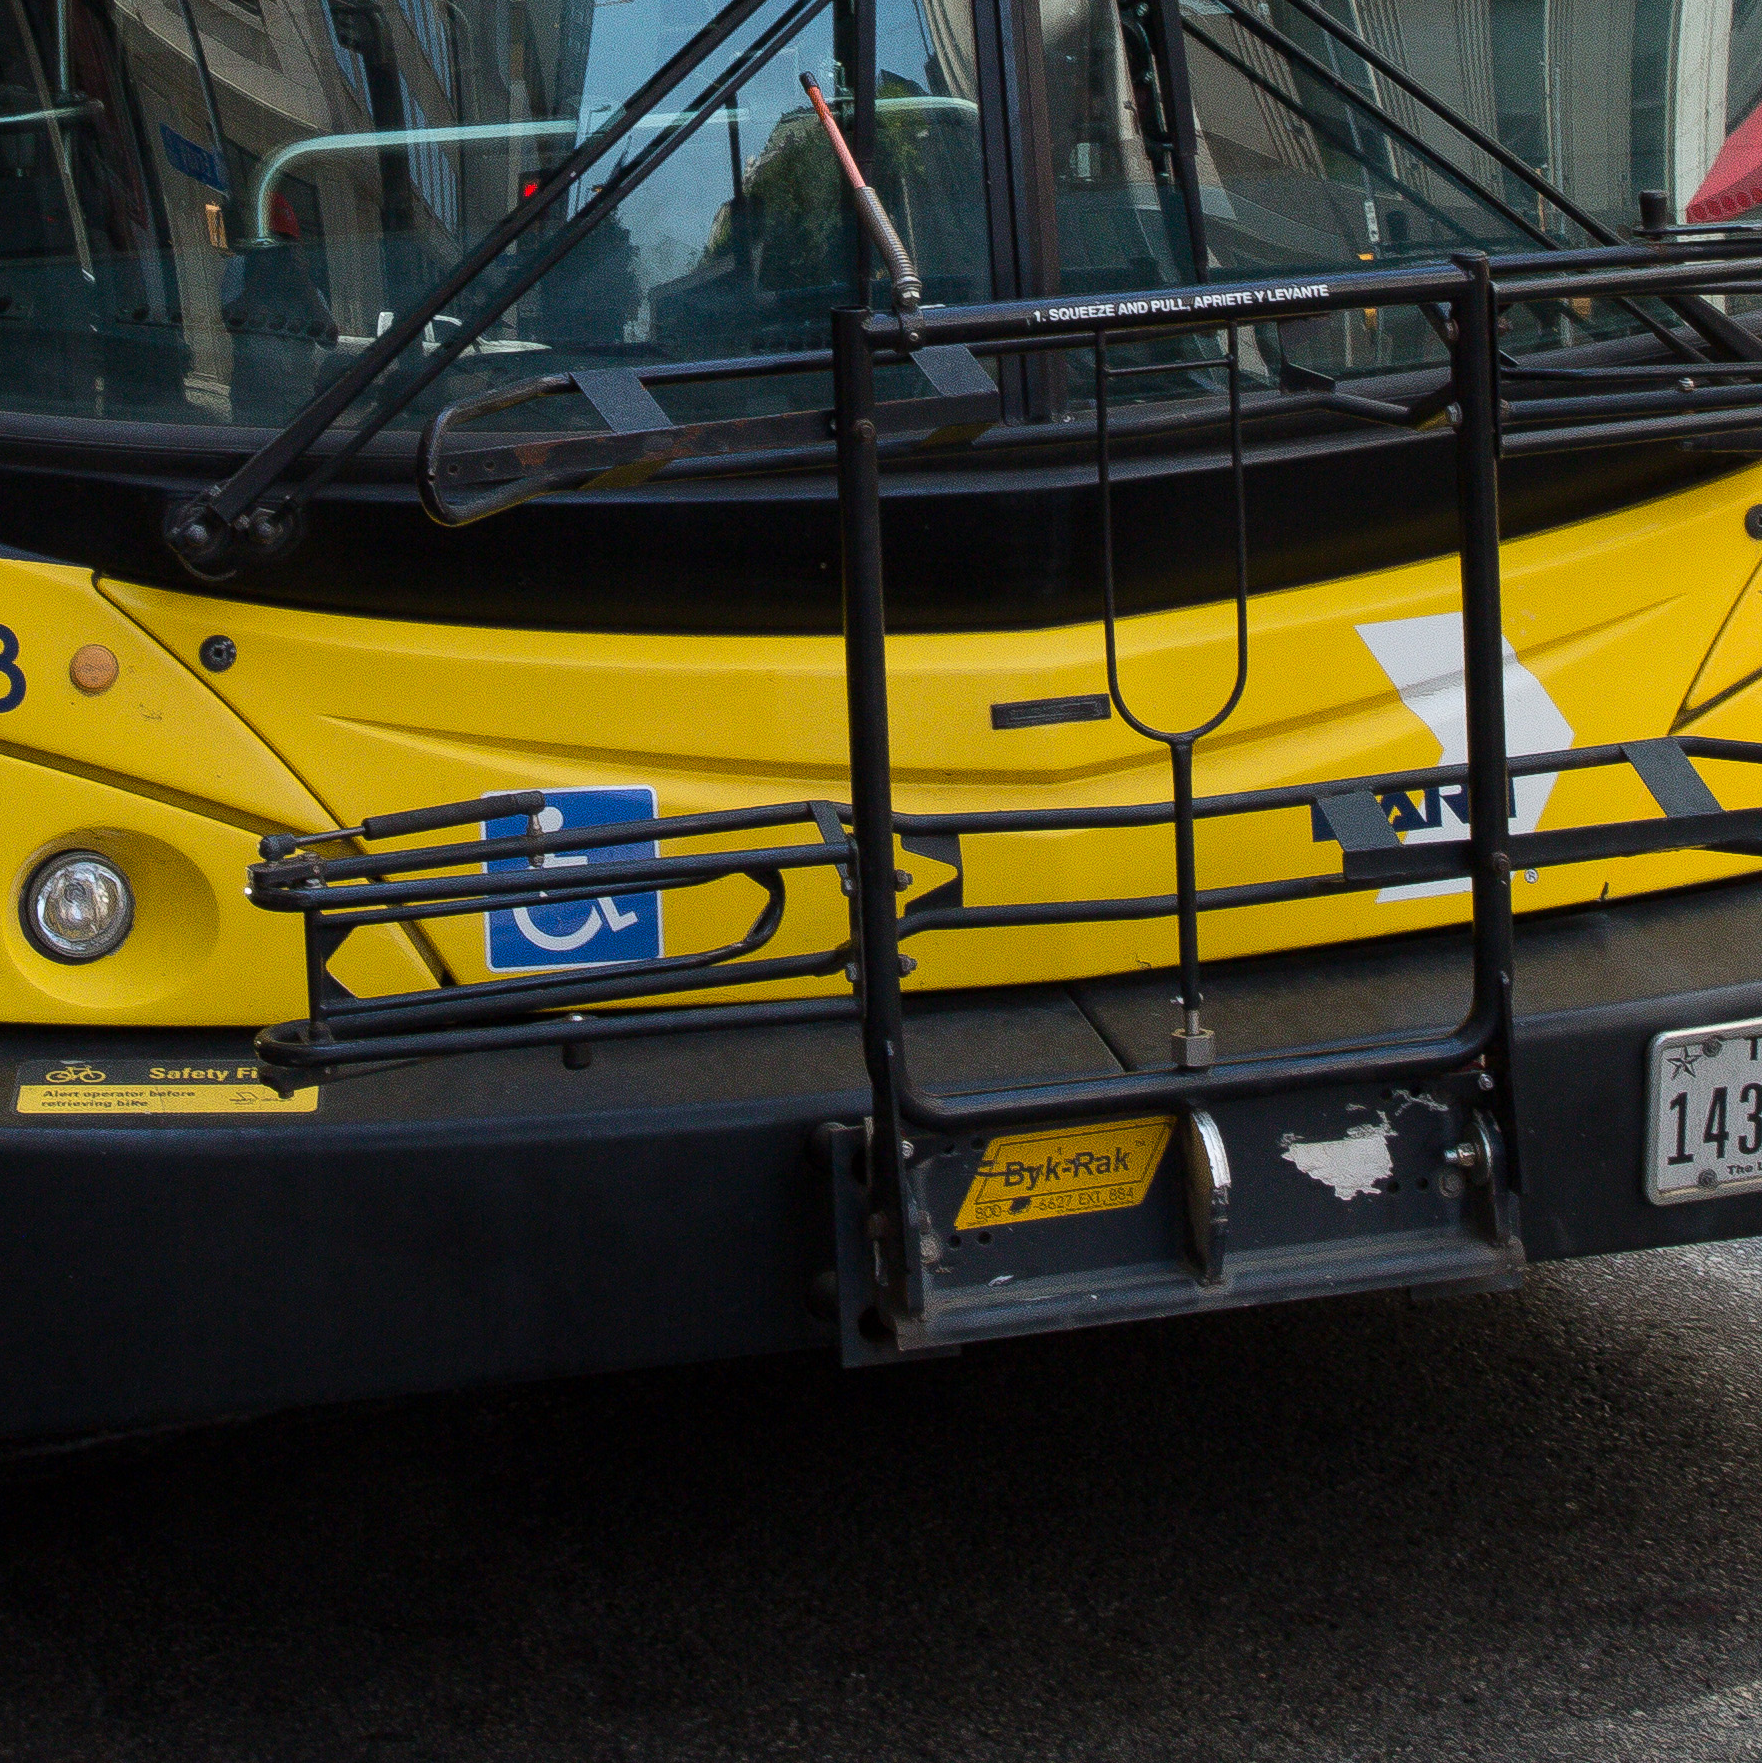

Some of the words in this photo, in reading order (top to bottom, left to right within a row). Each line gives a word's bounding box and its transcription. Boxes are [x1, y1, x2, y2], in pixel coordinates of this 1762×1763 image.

[1033, 310, 1046, 323] 1.
[1049, 303, 1116, 322] SQUEEZE
[1118, 300, 1148, 316] AND
[1150, 297, 1190, 314] PULL,
[1193, 290, 1252, 310] APRIETE
[1255, 289, 1265, 305] Y
[149, 1065, 227, 1083] Safety
[43, 1089, 78, 1100] Alert
[82, 1089, 135, 1102] operator
[137, 1089, 196, 1100] before
[41, 1098, 109, 1109] retrieving
[112, 1098, 150, 1109] bike
[1002, 1145, 1131, 1191] Byk-Rak
[1726, 1163, 1754, 1176] The
